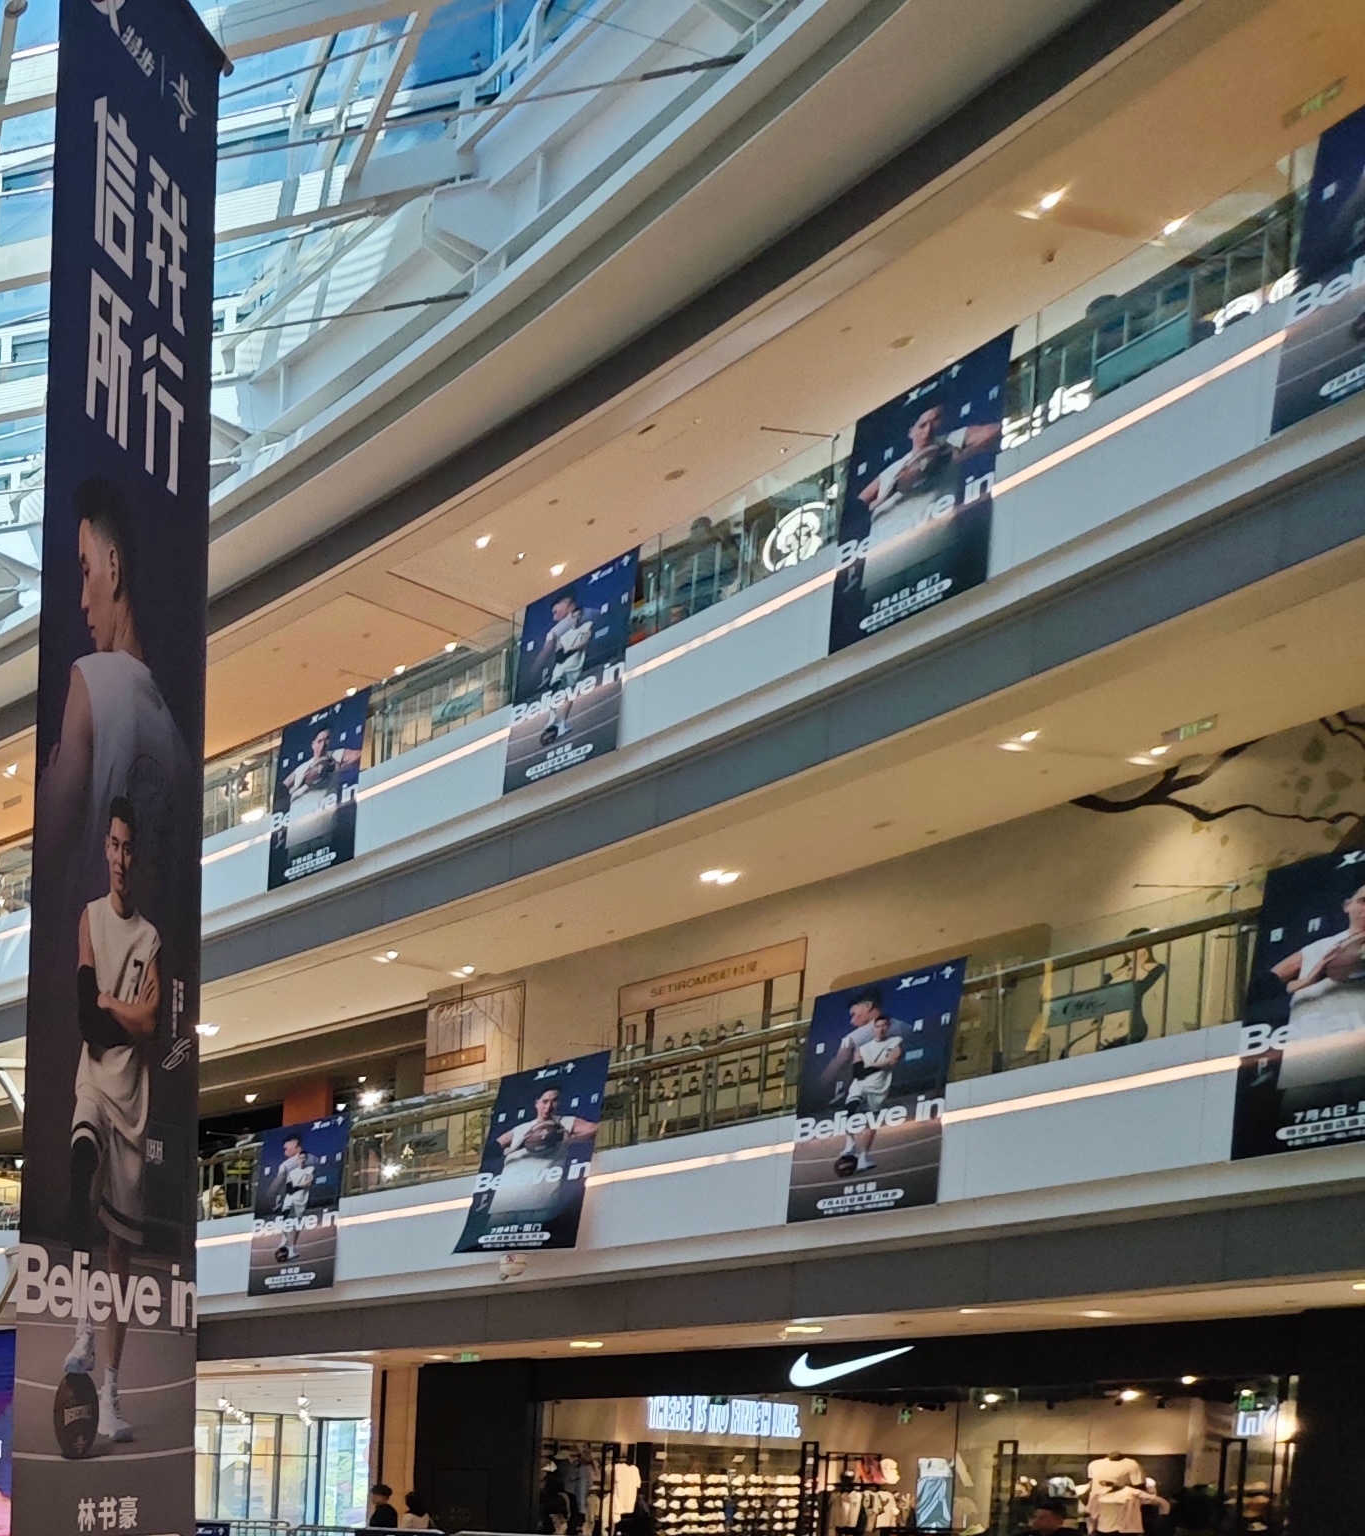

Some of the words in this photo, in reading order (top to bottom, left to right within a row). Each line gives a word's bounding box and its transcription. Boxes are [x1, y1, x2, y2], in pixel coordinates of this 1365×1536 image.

[963, 471, 995, 505] in
[511, 675, 597, 723] Believe
[602, 661, 626, 687] in
[341, 783, 359, 803] in
[794, 1103, 908, 1142] Believe
[915, 1094, 946, 1122] in
[566, 1158, 592, 1181] in
[252, 1215, 318, 1238] Believe
[321, 1208, 339, 1228] in
[16, 1243, 161, 1327] Believe
[170, 1263, 197, 1330] in
[77, 1495, 139, 1532] 林书豪
